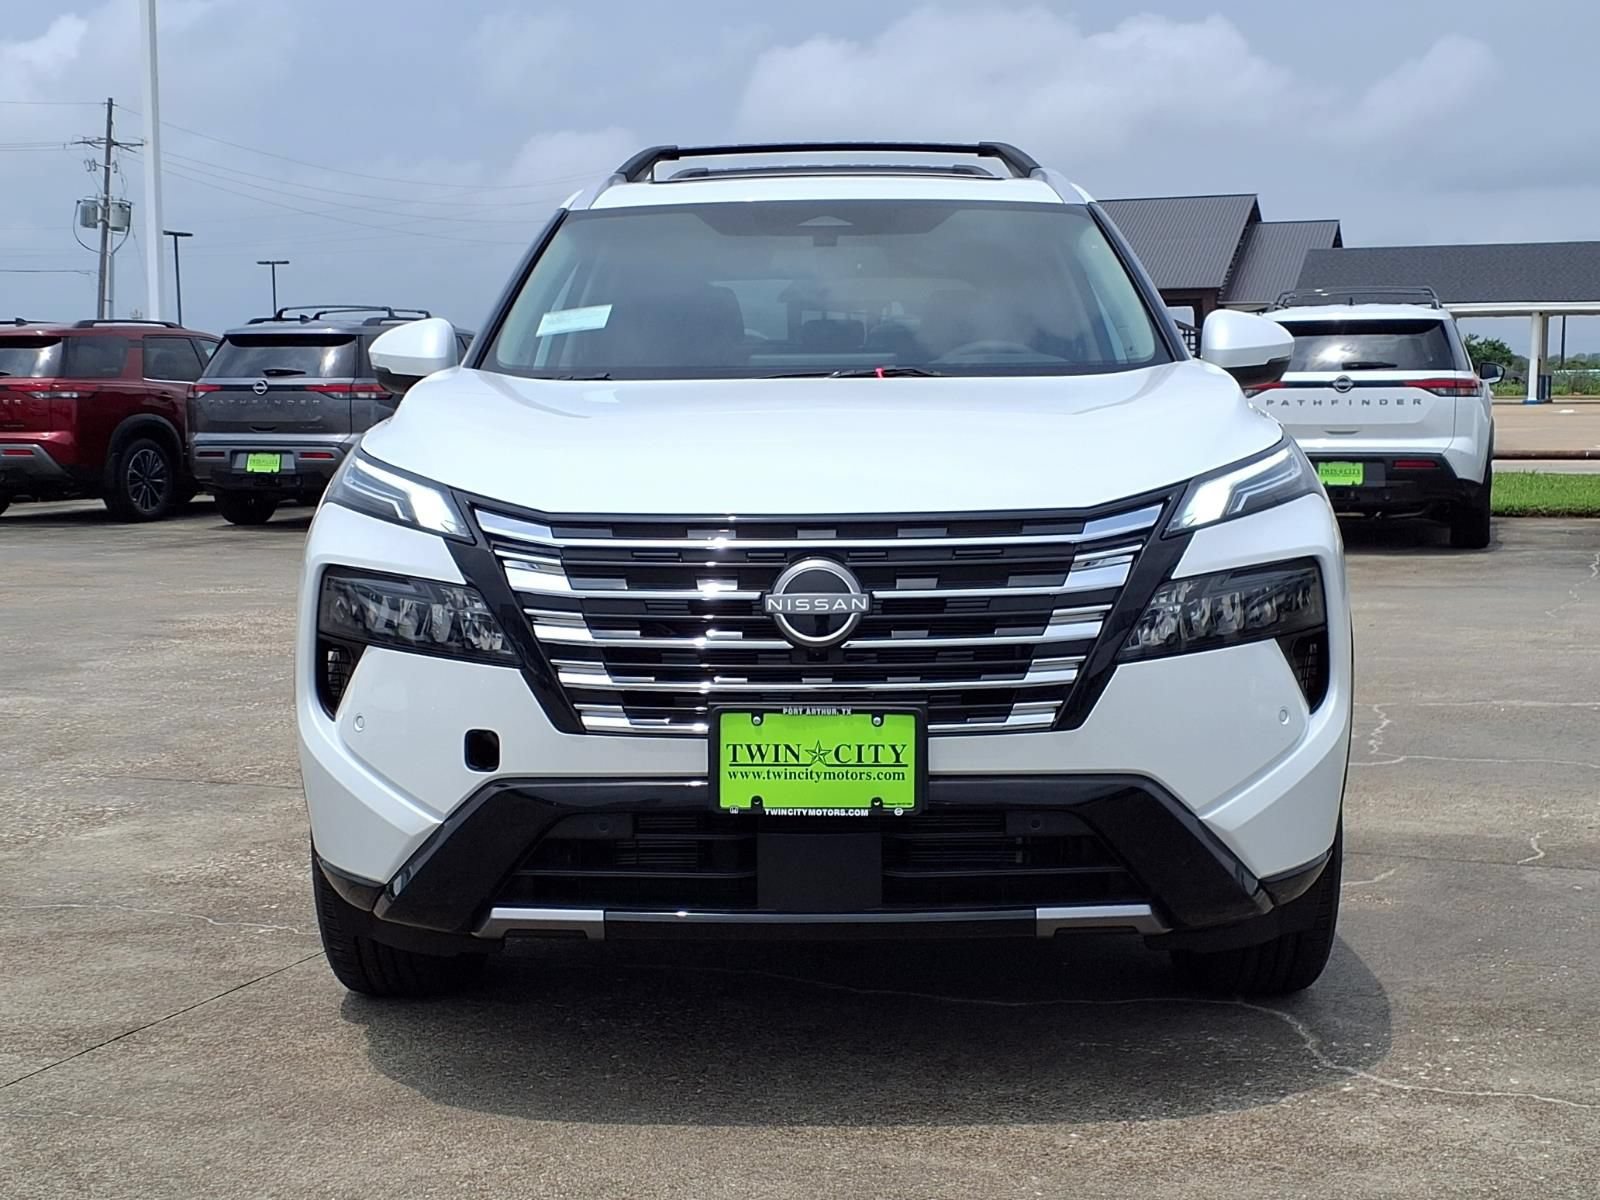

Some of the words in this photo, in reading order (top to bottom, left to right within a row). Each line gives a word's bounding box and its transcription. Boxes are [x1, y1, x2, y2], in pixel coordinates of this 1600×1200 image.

[1265, 398, 1423, 407] PATHFINDER
[767, 598, 867, 611] NISSAN
[782, 706, 803, 716] PORT
[841, 706, 852, 716] TX
[726, 743, 802, 764] TWIN
[833, 743, 908, 765] CITY
[728, 767, 906, 784] www.twincitymotors.com
[764, 808, 870, 817] TWINCITYMOTORS.COM
